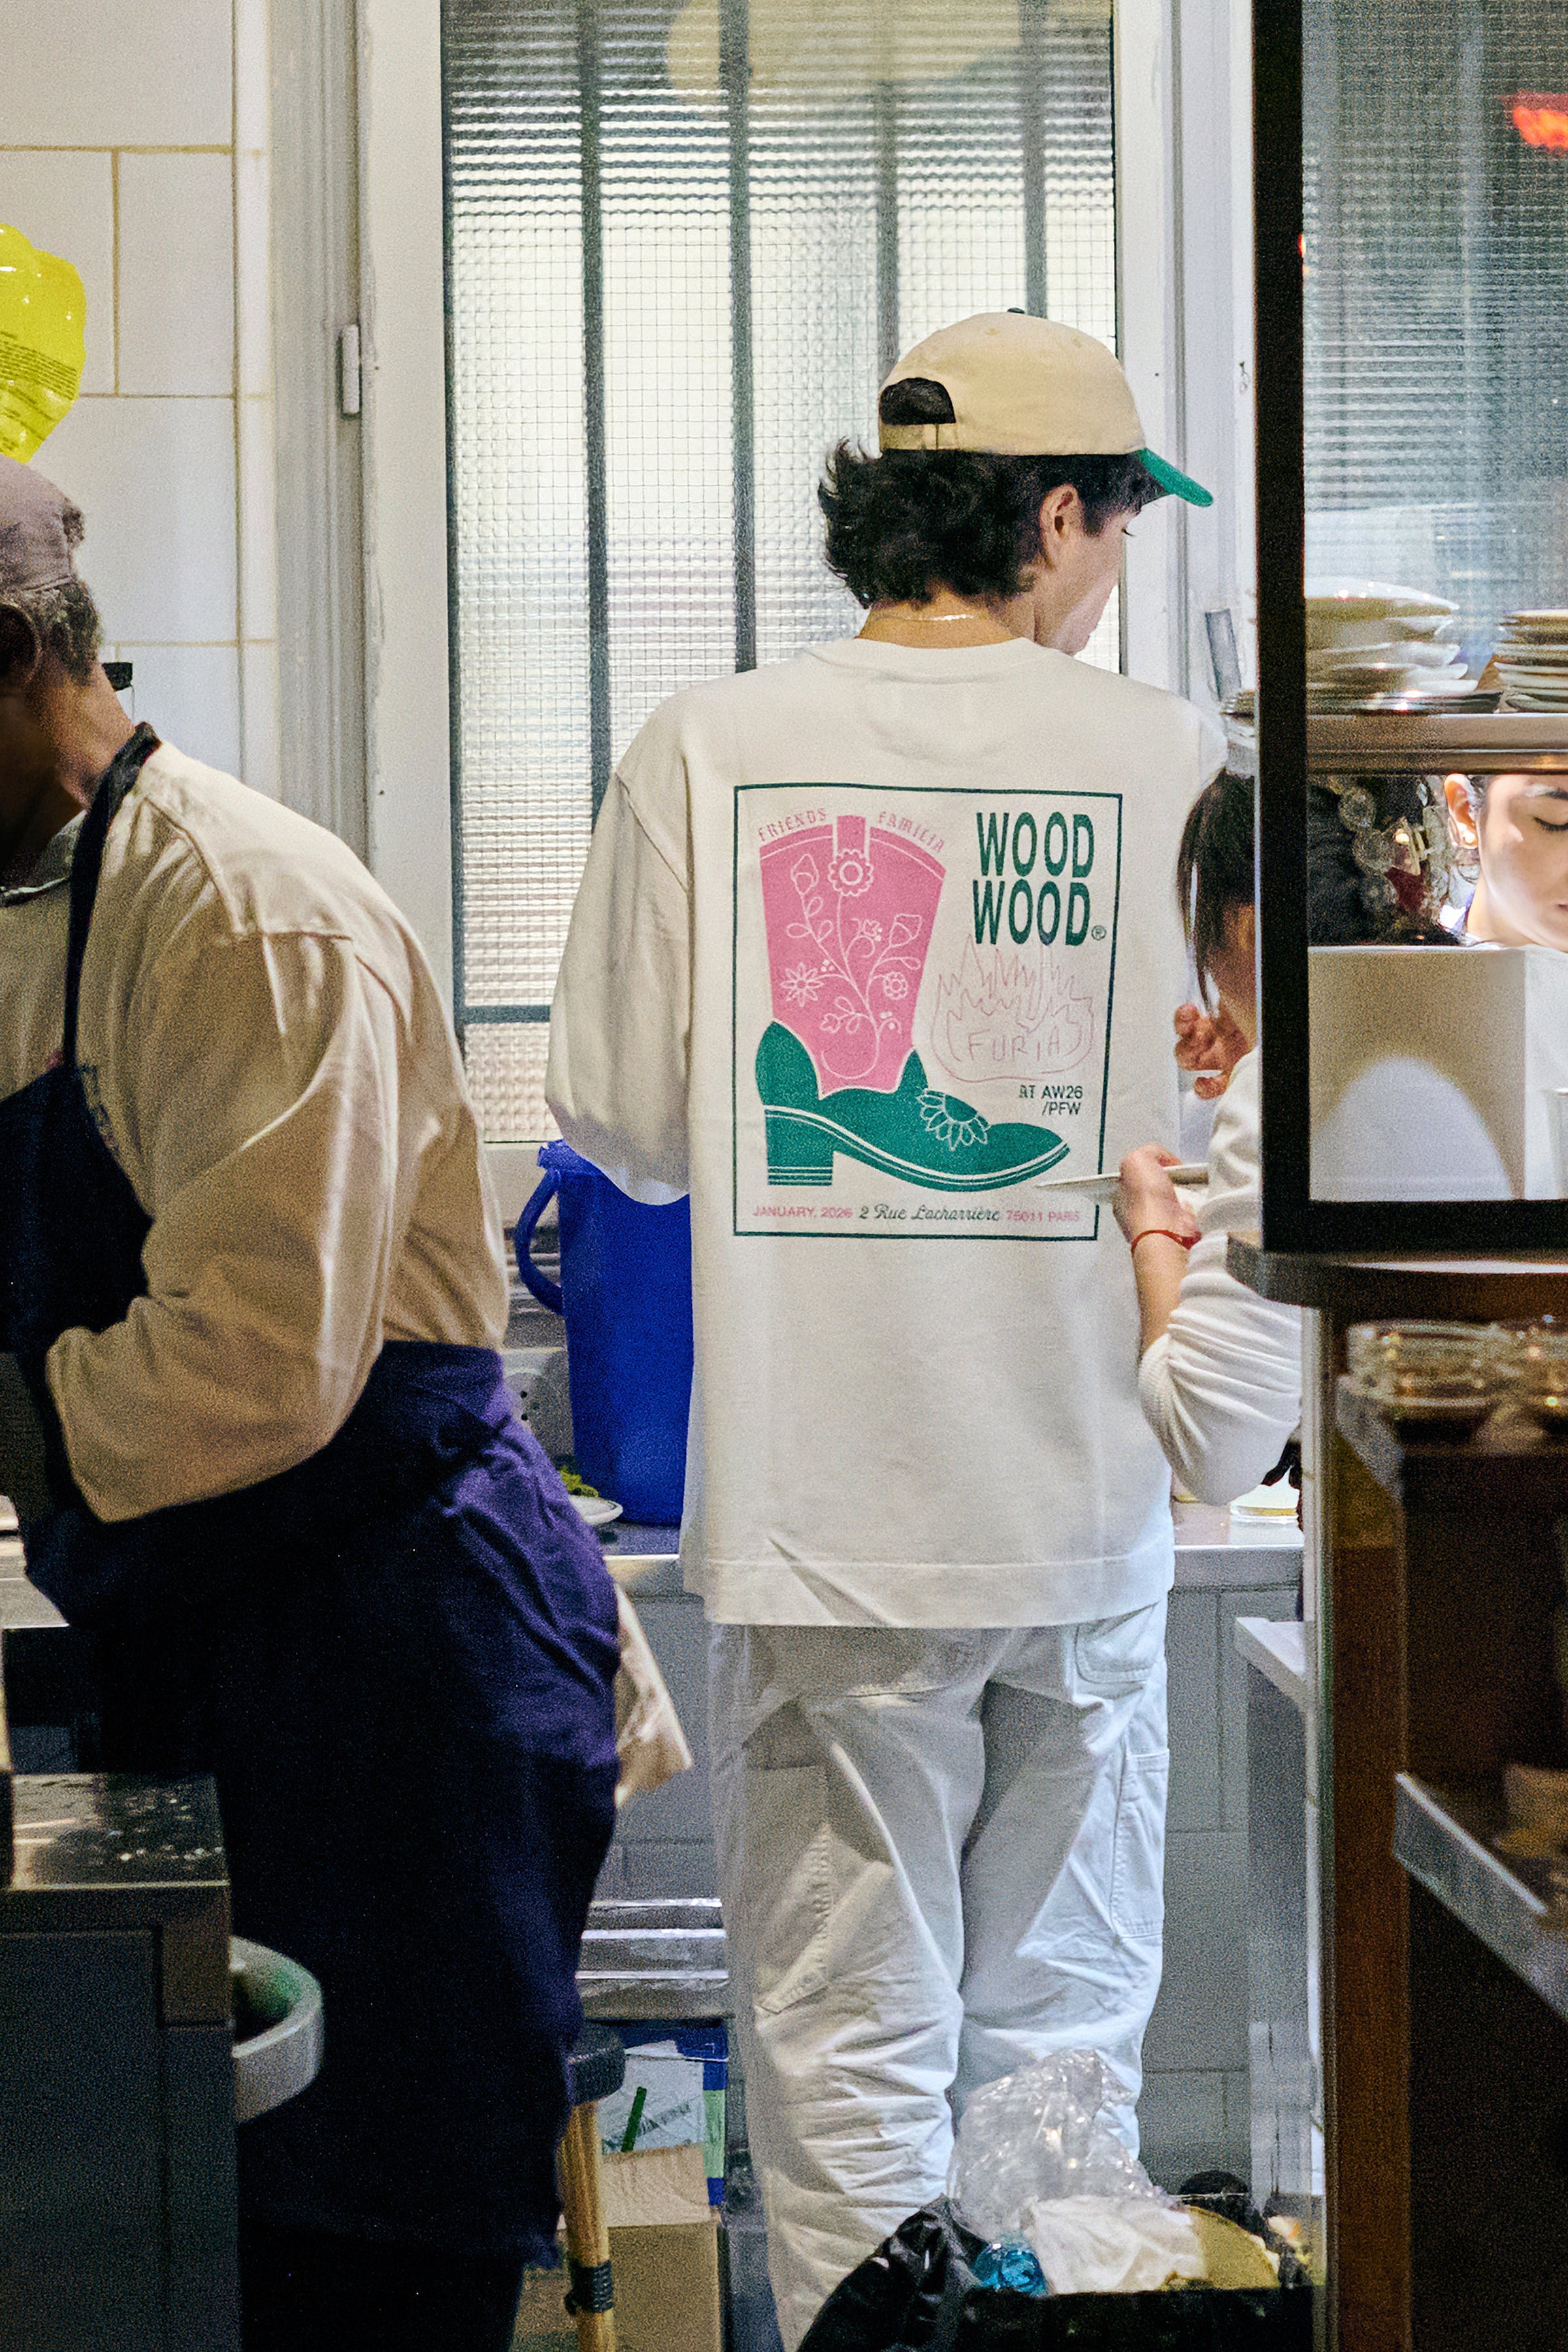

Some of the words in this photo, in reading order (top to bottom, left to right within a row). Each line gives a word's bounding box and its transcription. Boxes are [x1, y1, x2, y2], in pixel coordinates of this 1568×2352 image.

[757, 807, 826, 841] FRIENDS
[877, 811, 945, 853] FAMILIA
[977, 811, 1094, 878] WOOD
[968, 1025, 1060, 1062] FURIA
[1019, 1085, 1036, 1098] AT
[1041, 1086, 1083, 1099] AW26
[1041, 1102, 1081, 1115] /PFW
[821, 1206, 853, 1219] 2026
[858, 1205, 870, 1220] 2
[874, 1203, 907, 1220] Rue
[1005, 1209, 1043, 1222] 75011
[1048, 1211, 1080, 1223] PARIS
